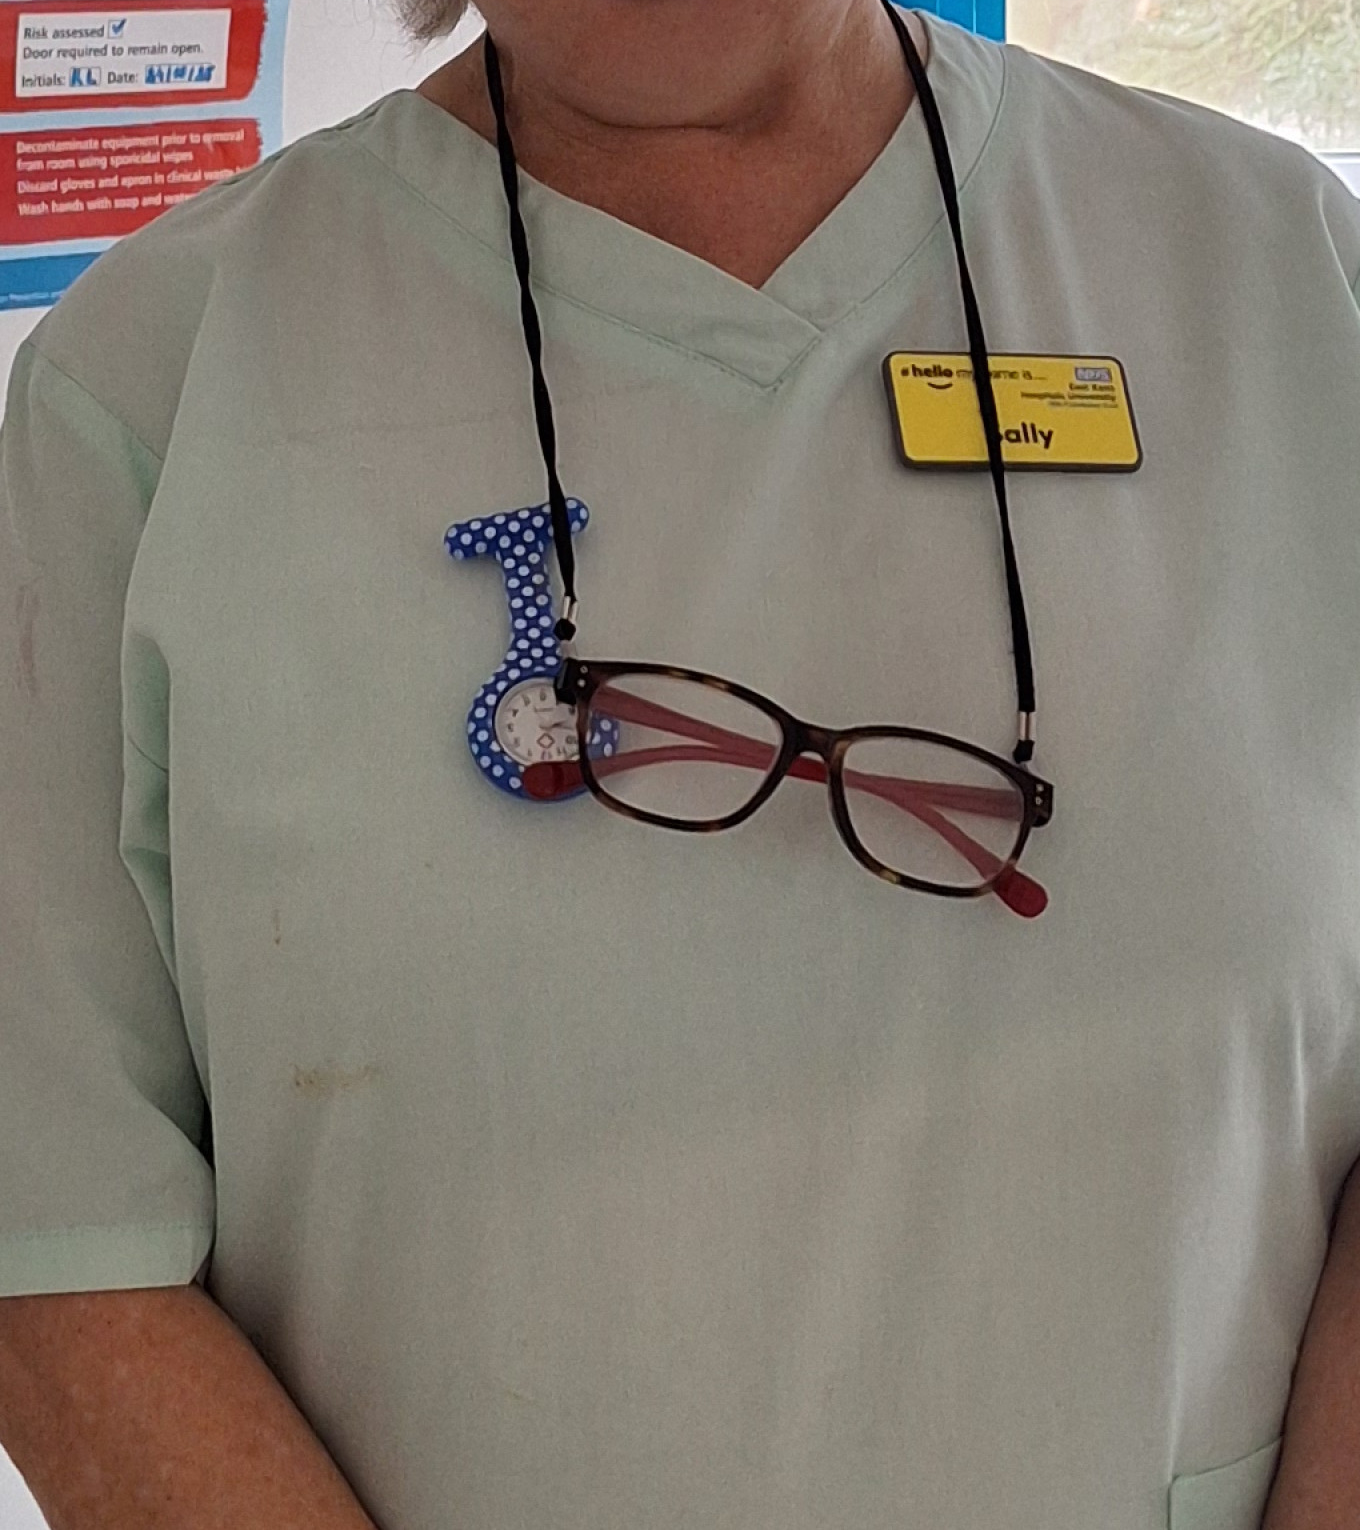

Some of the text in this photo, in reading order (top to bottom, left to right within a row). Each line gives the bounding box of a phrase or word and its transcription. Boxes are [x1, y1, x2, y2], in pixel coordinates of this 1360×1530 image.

[23, 24, 105, 40] Risk assessed
[23, 42, 204, 60] Door required to remain open.
[21, 72, 66, 88] Initials:
[107, 71, 138, 84] Date:
[59, 177, 96, 194] gloves
[98, 174, 119, 188] and
[18, 200, 49, 216] Wash
[141, 192, 162, 207] and
[1000, 421, 1054, 449] ally
